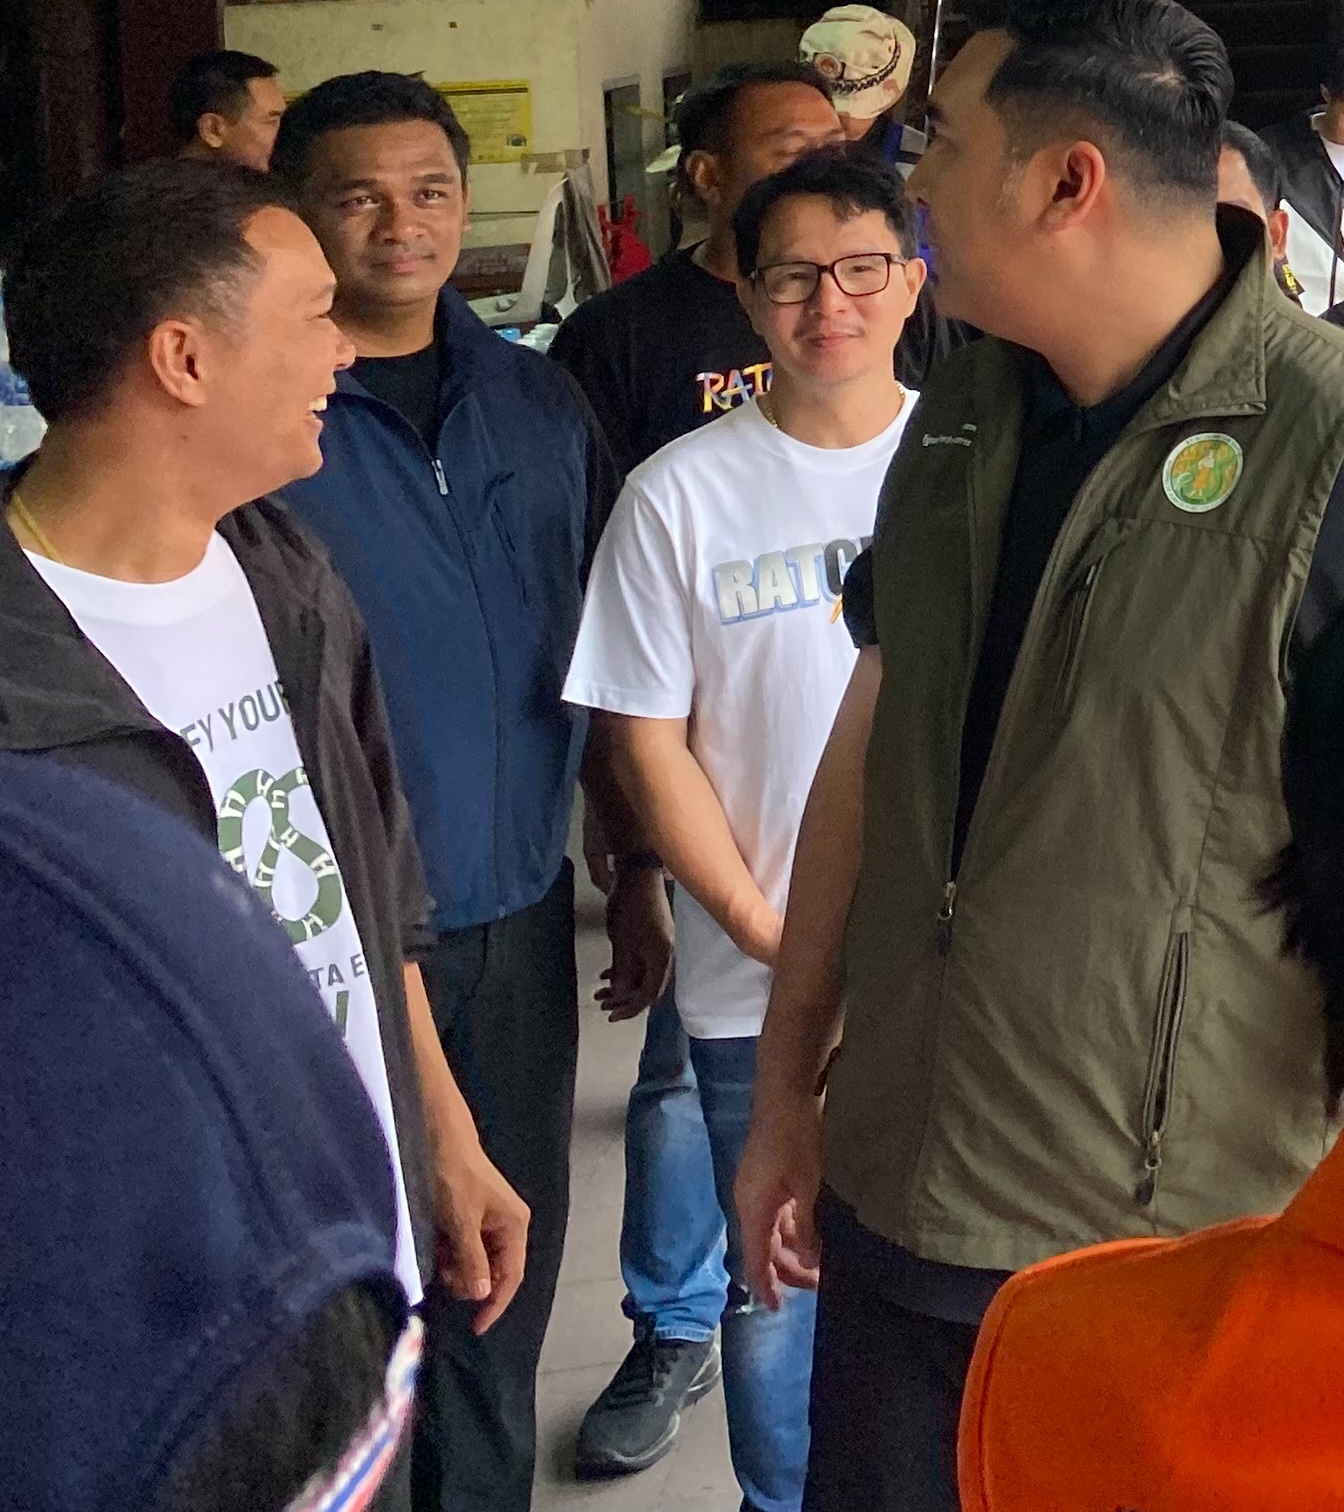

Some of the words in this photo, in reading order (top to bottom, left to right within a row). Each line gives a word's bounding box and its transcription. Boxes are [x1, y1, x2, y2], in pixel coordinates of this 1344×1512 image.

[696, 362, 774, 413] RAT
[714, 538, 862, 624] RATC
[218, 680, 288, 740] YOU
